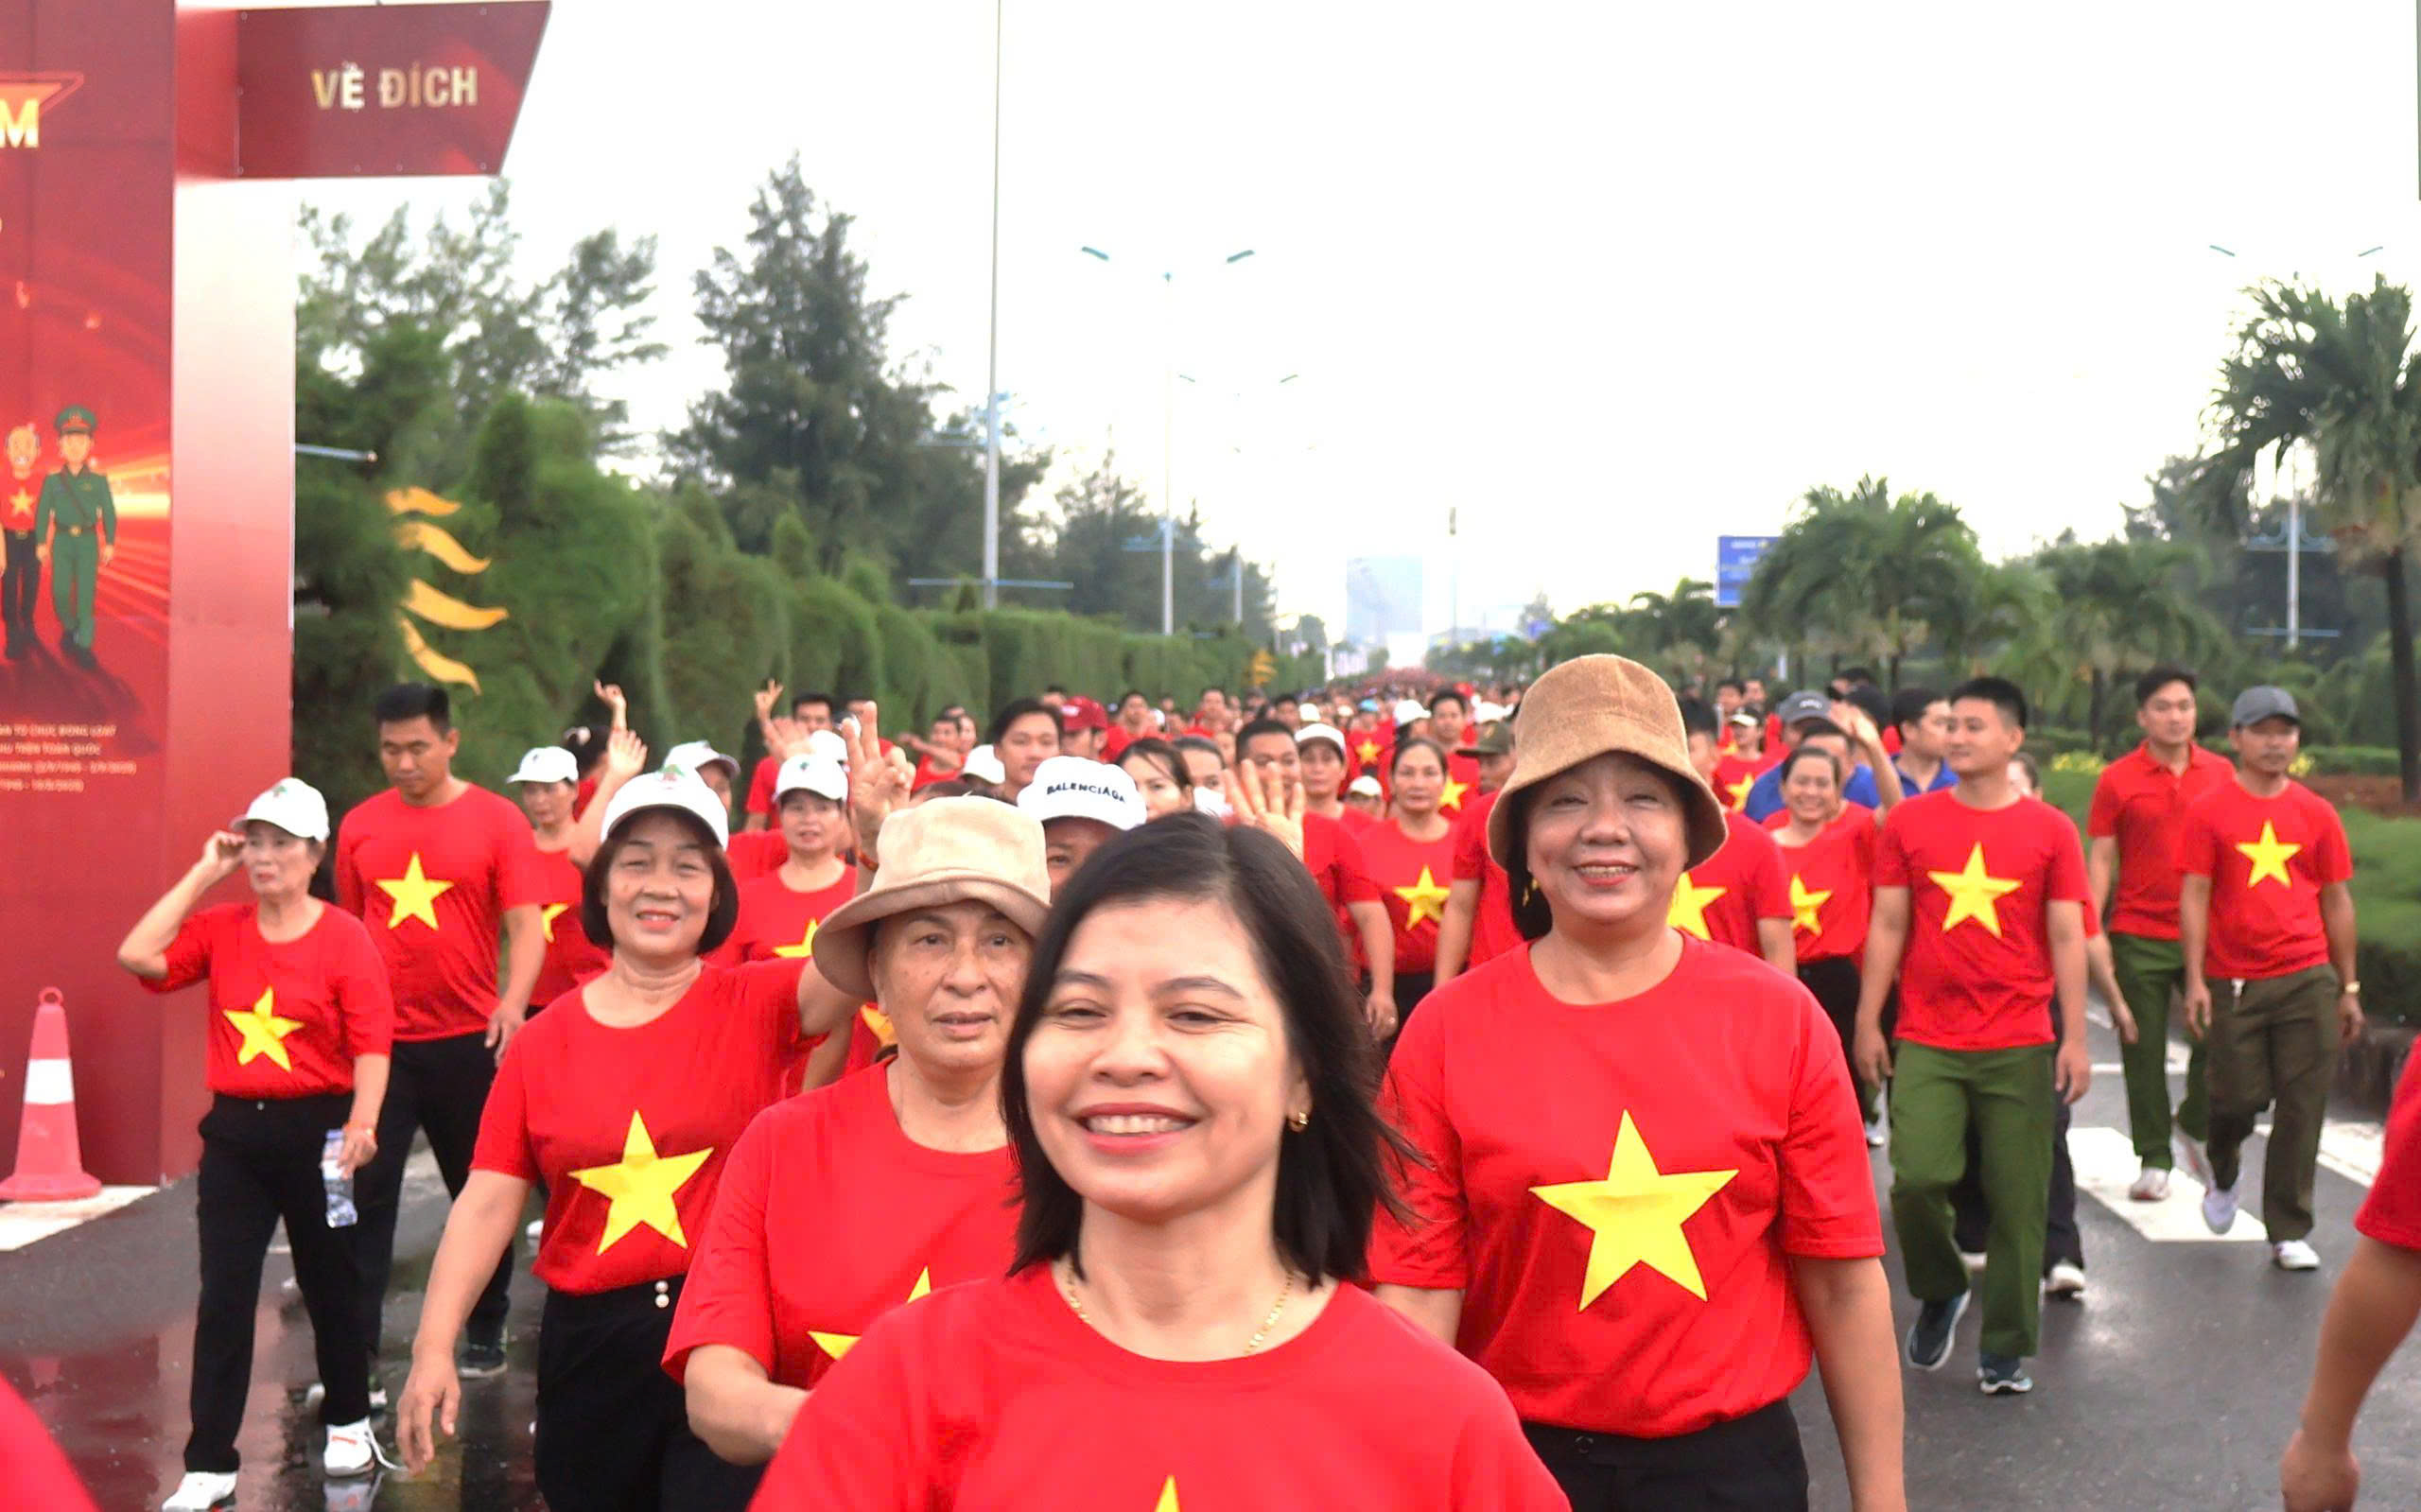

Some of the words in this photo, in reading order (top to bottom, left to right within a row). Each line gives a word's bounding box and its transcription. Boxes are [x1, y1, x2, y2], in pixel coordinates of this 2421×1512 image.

[311, 61, 365, 110] VỀ
[378, 61, 478, 108] ĐÍCH
[1046, 781, 1126, 803] BALENCIAGA
